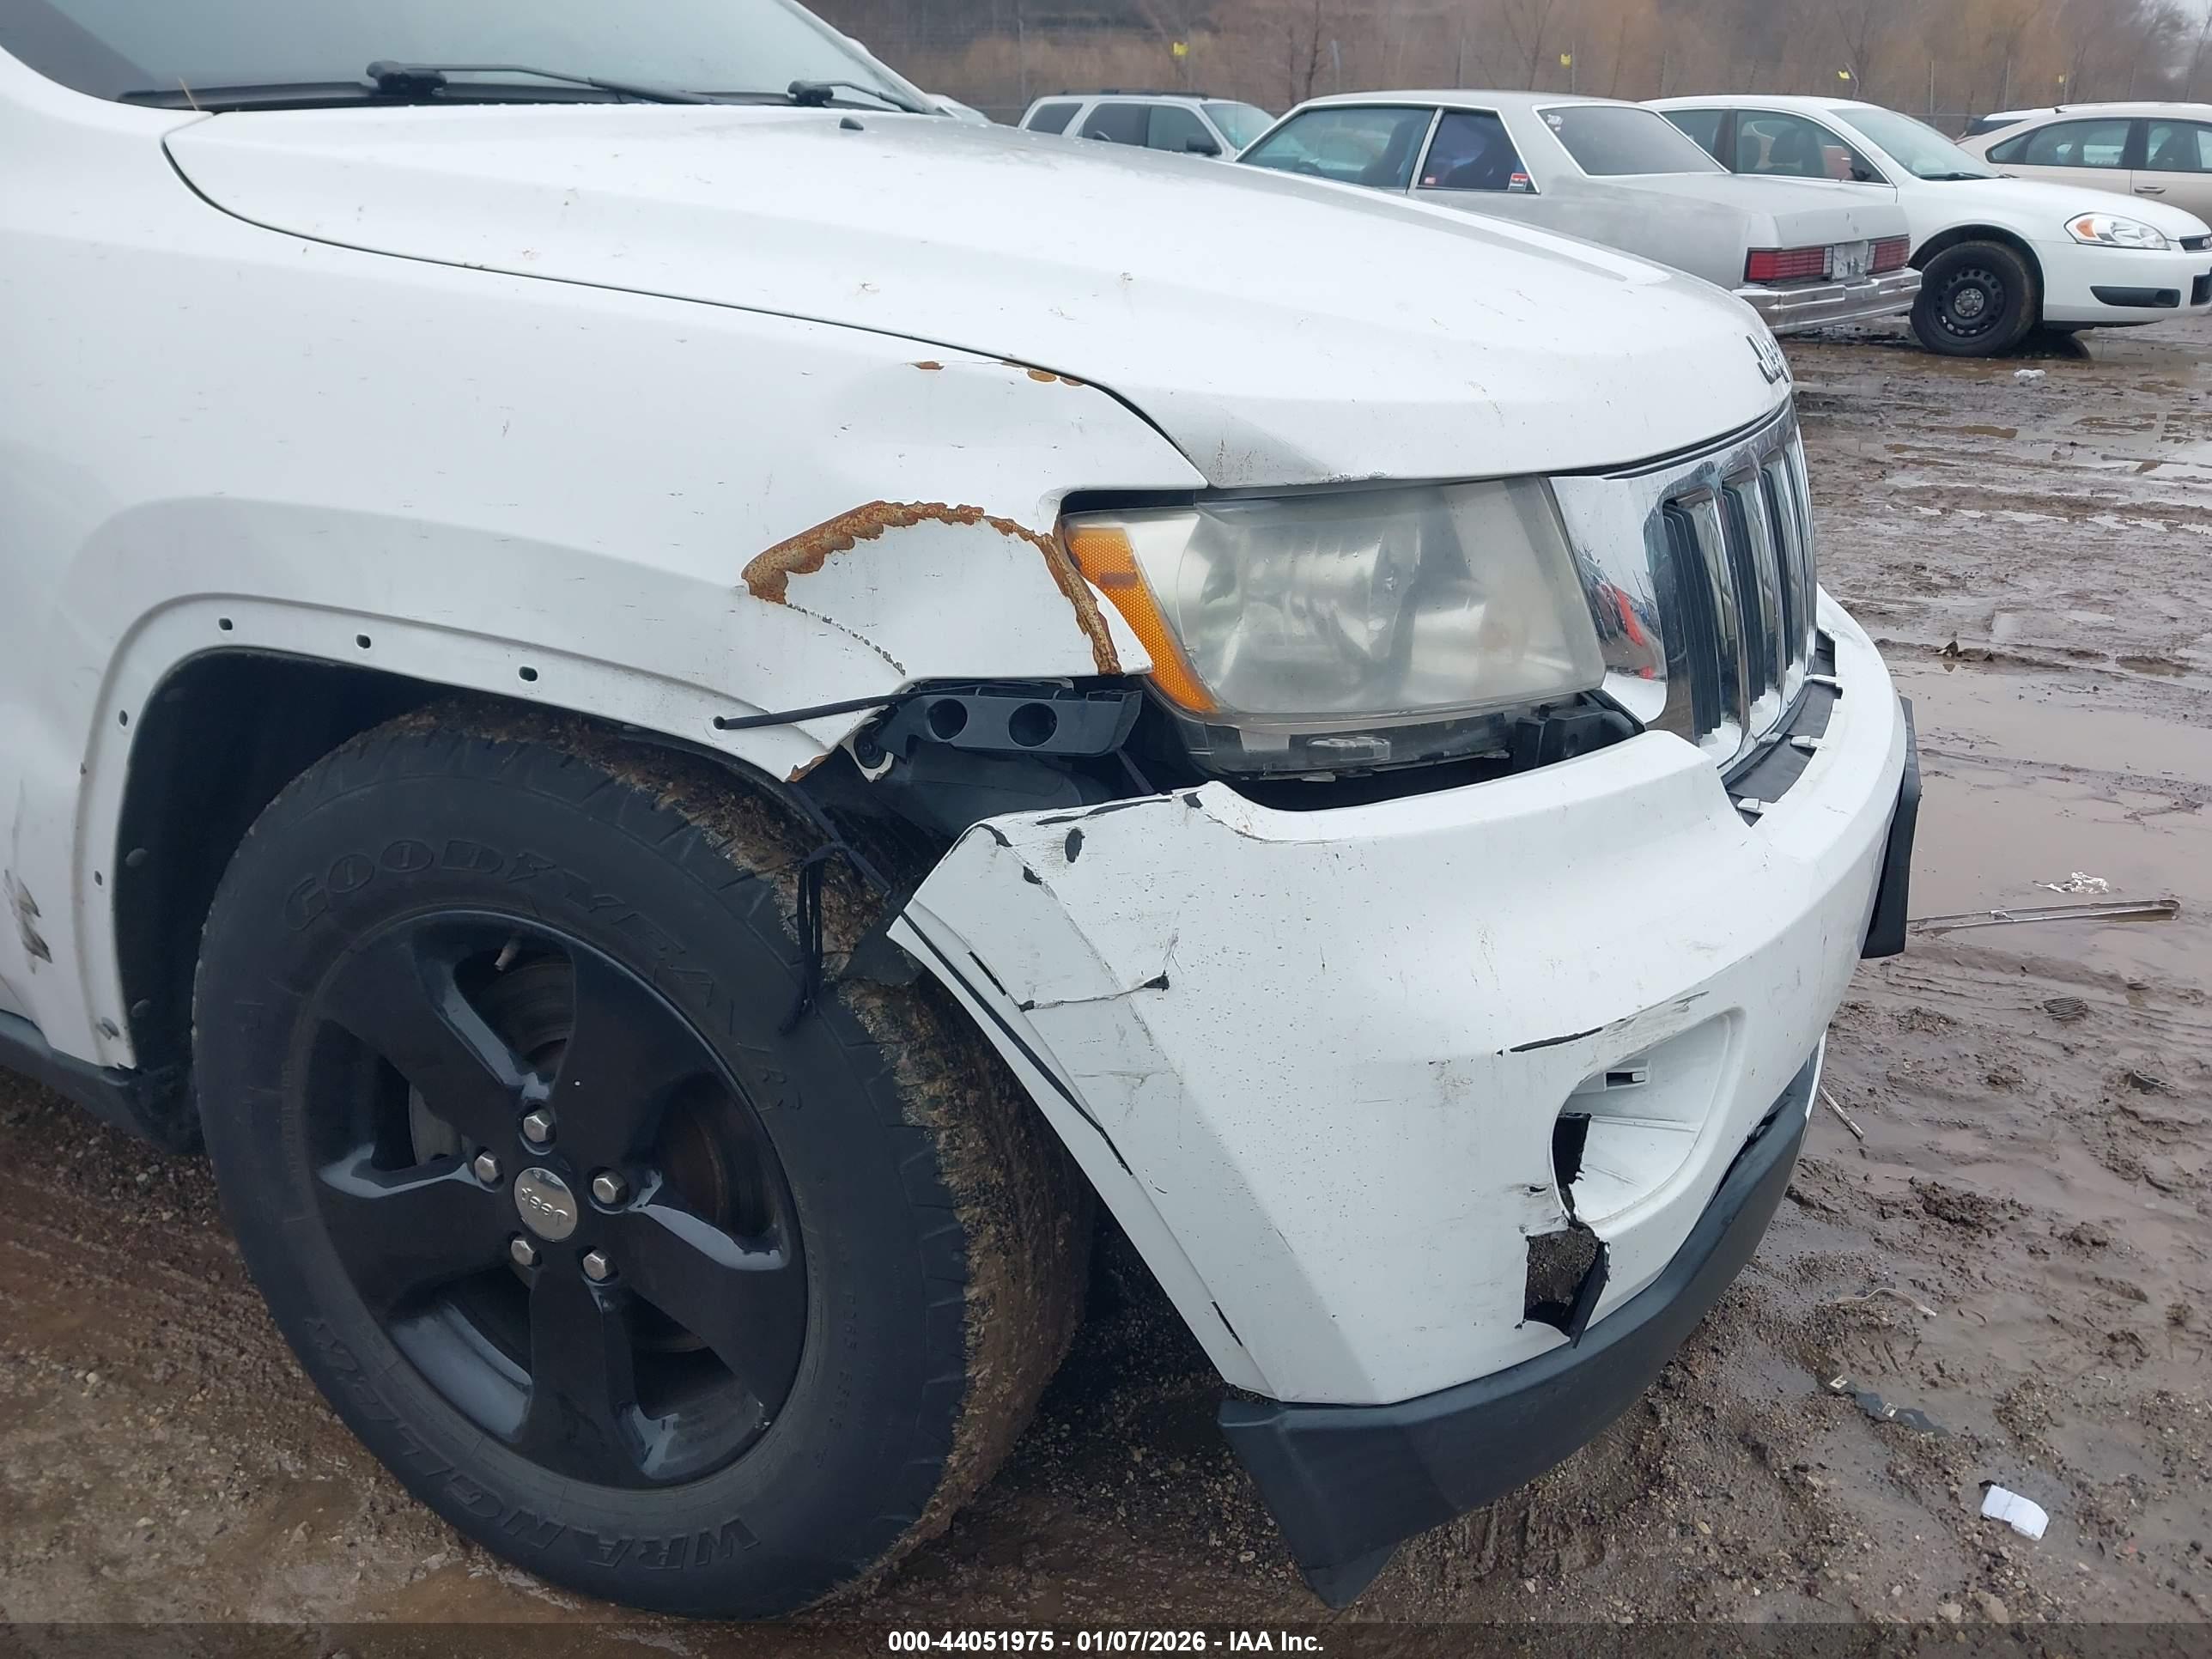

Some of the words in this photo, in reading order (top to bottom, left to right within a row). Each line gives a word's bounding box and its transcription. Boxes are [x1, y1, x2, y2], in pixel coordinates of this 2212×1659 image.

[283, 837, 802, 1112] GOODYEAR
[520, 1187, 569, 1227] Jeep
[303, 1316, 761, 1570] WRANGLER
